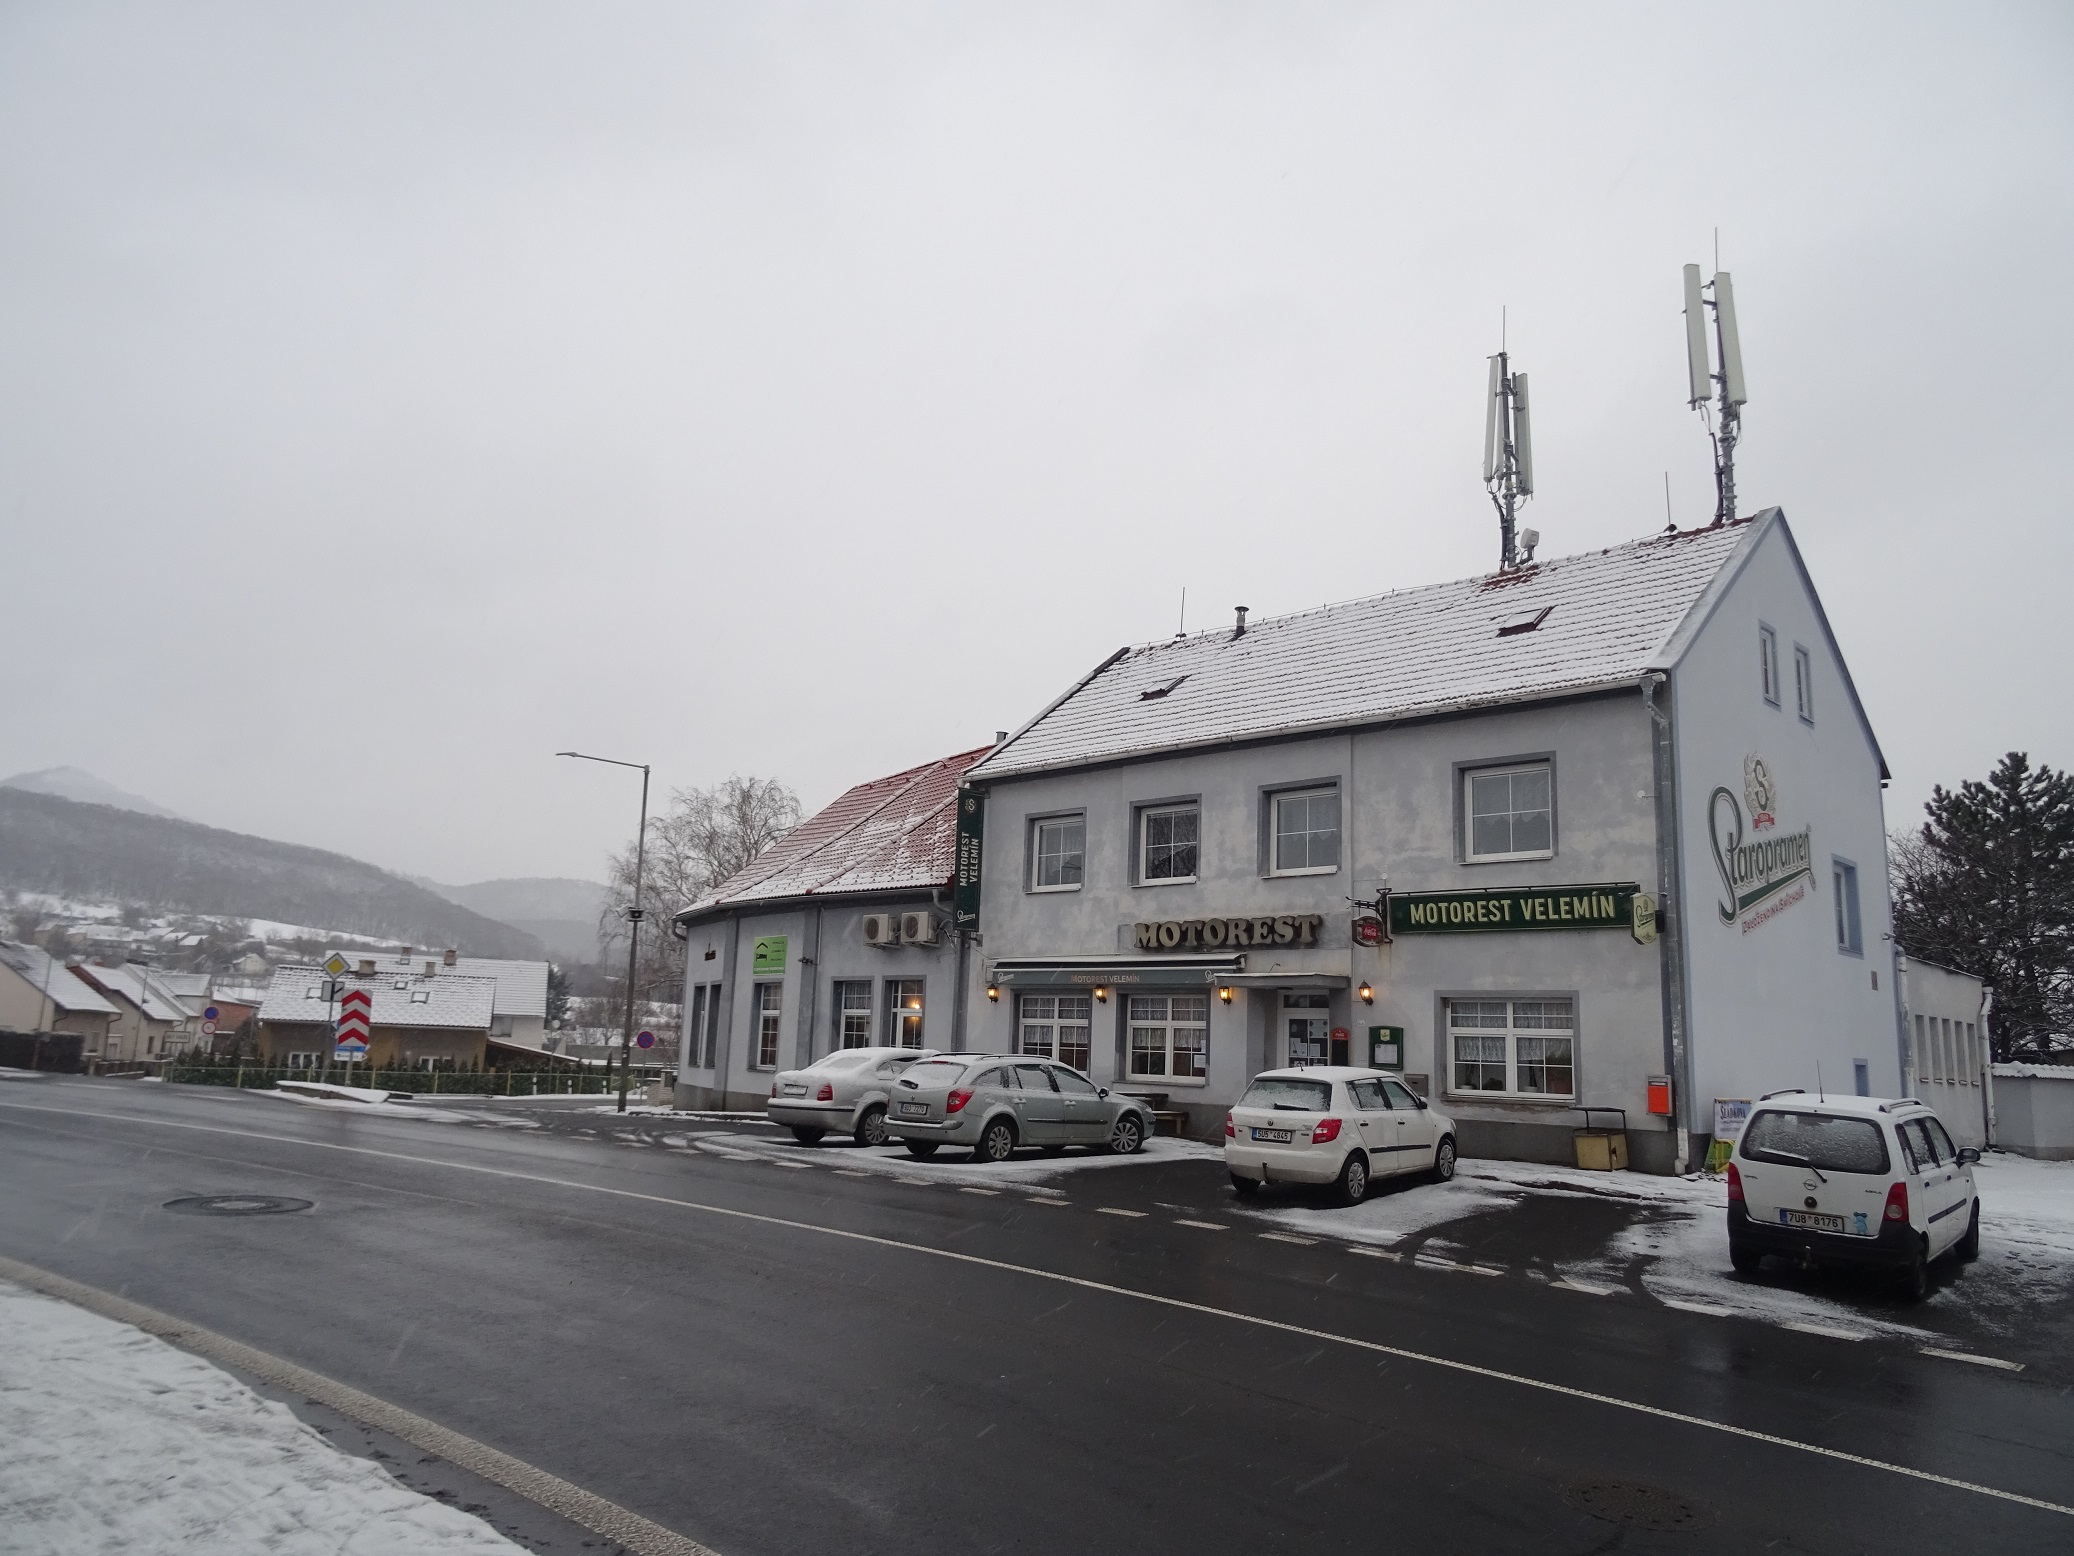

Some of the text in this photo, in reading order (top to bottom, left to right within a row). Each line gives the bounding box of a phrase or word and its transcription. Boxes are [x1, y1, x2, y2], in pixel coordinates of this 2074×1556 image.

[960, 831, 970, 887] MOTOREST
[969, 838, 979, 883] VELEMÍN
[1707, 783, 1812, 926] Staropramen
[1409, 891, 1615, 924] MOTOREST VELEMÍN
[1134, 914, 1320, 948] MOTOREST
[1071, 973, 1140, 983] MOTOREST VELEMÍN
[1788, 1212, 1839, 1228] 7U8 8176
